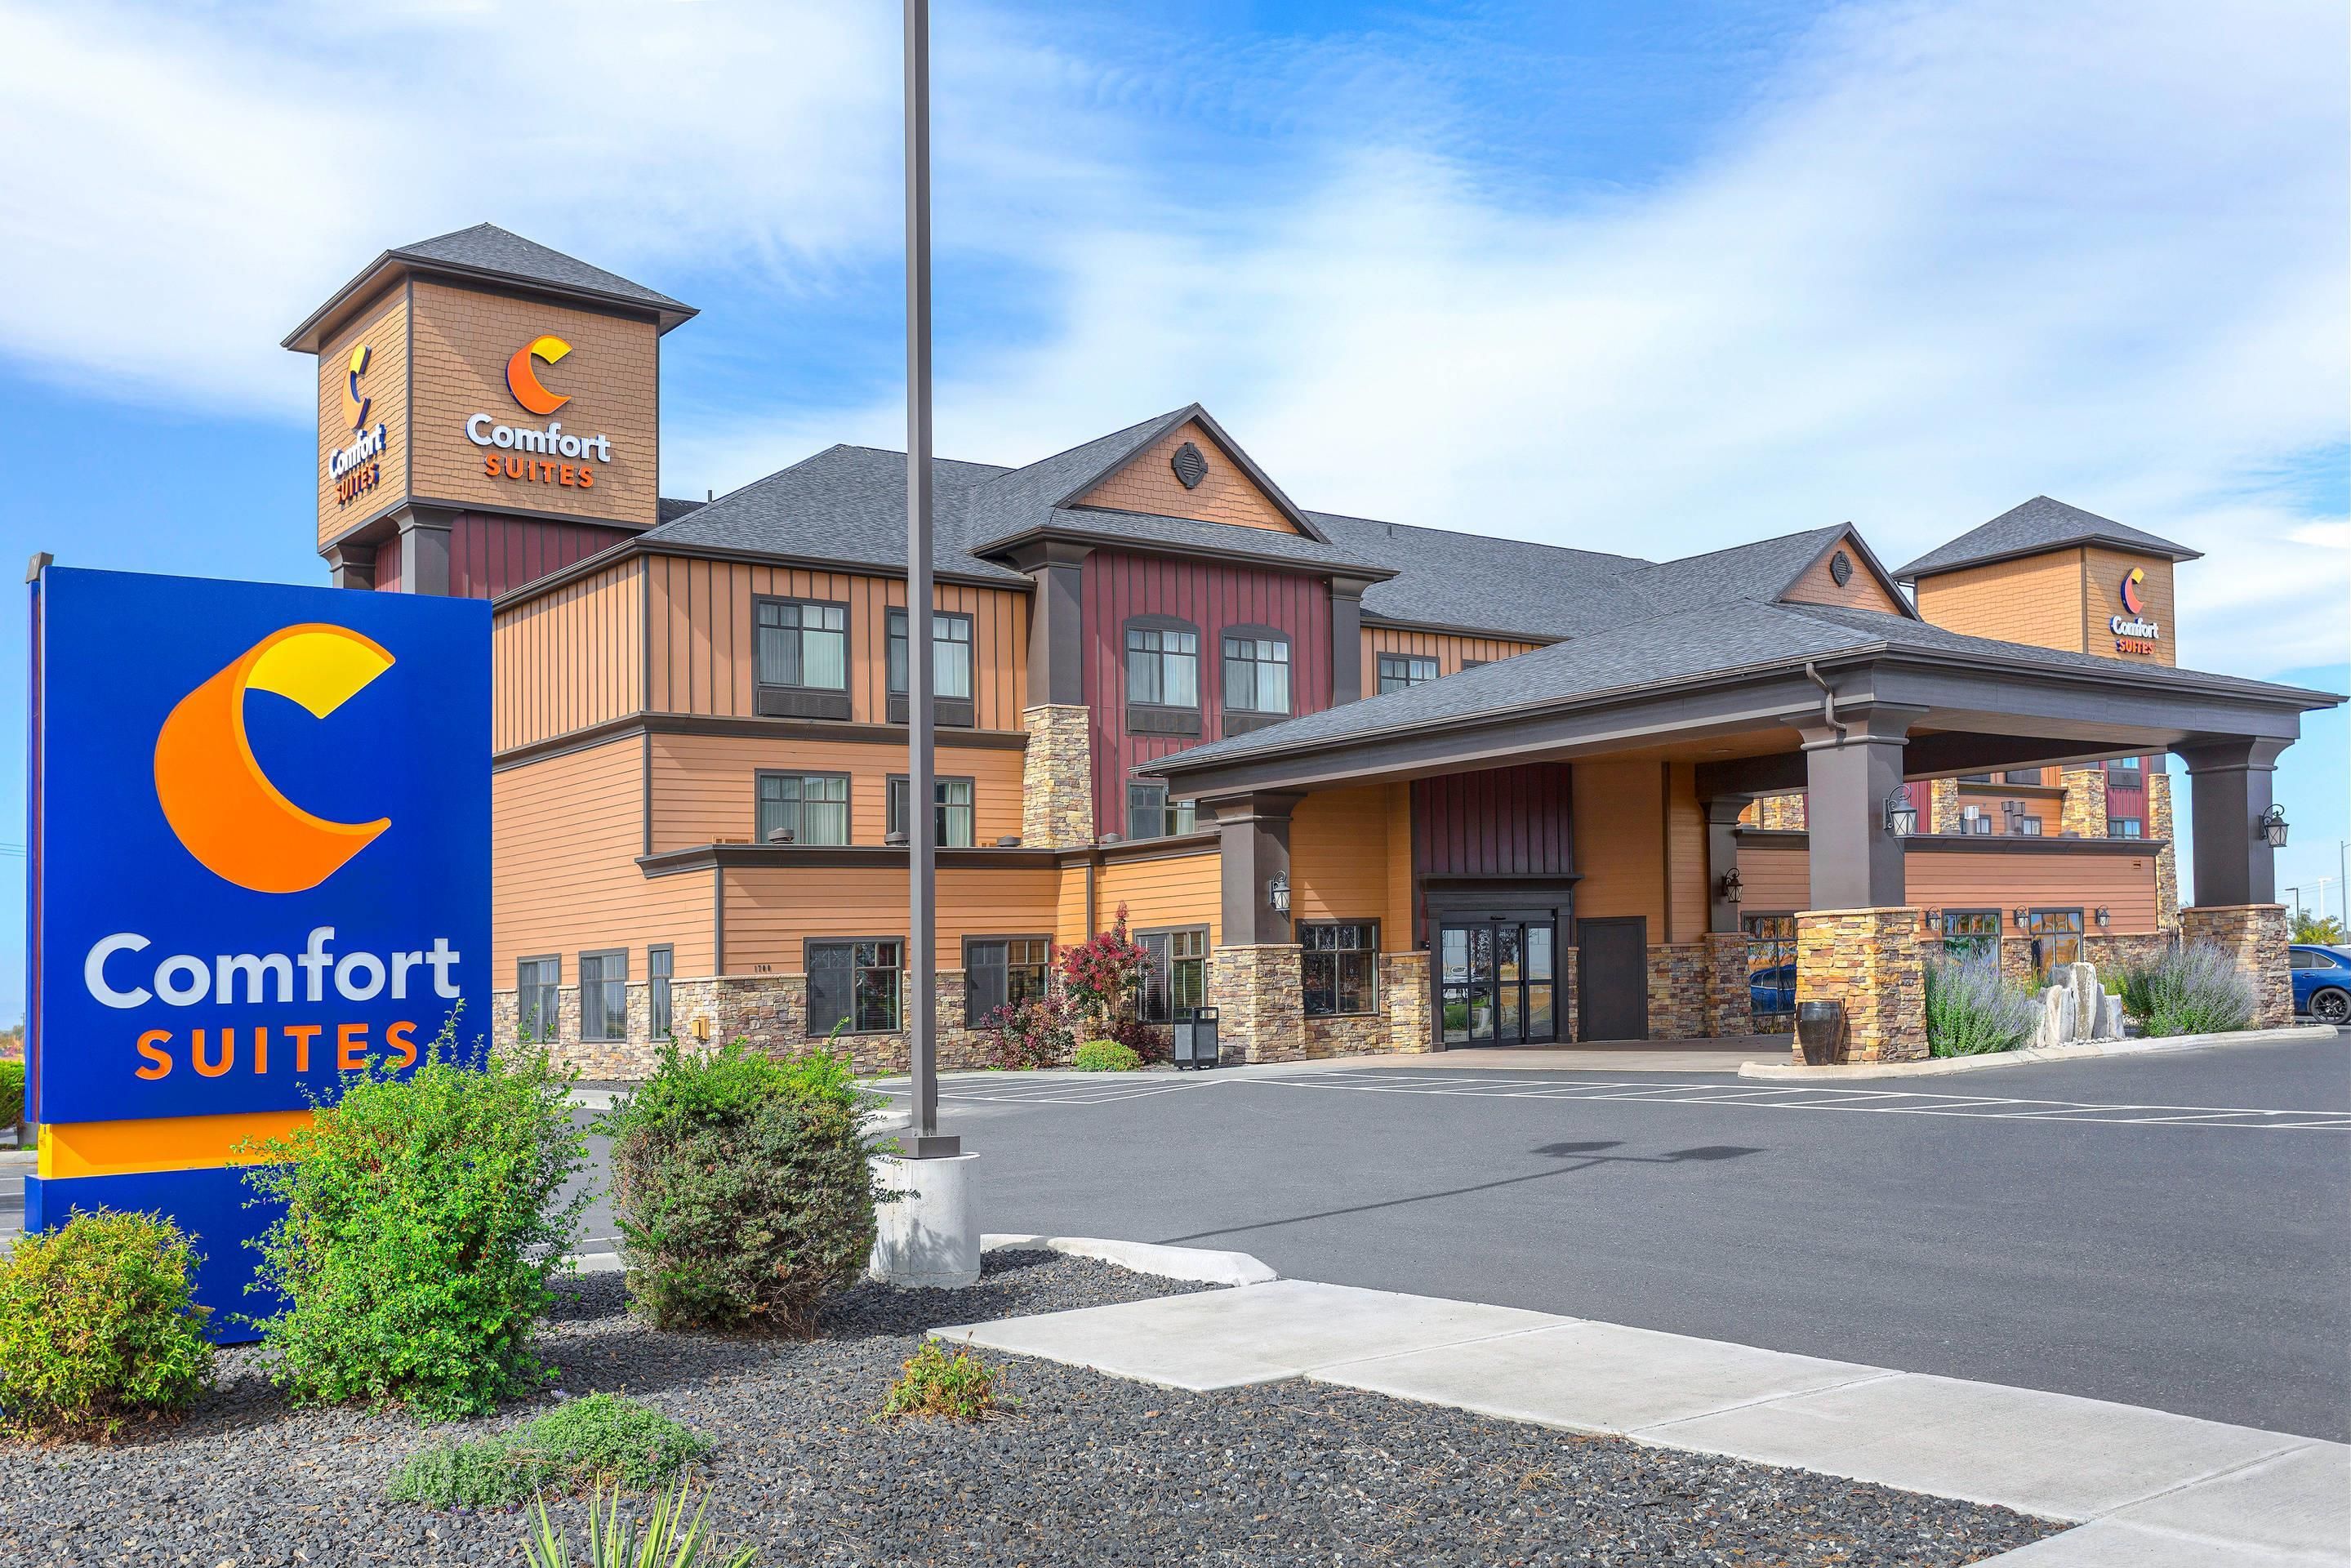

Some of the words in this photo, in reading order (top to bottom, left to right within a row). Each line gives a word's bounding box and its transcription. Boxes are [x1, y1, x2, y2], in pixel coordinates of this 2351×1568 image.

[329, 423, 385, 479] Comfort
[466, 413, 611, 462] Comfort
[336, 462, 378, 504] SUITES
[485, 454, 594, 488] SUITES
[2110, 615, 2159, 639] Comfort
[2117, 639, 2156, 655] SUITES
[84, 926, 461, 1009] Comfort
[135, 1021, 418, 1080] SUITES
